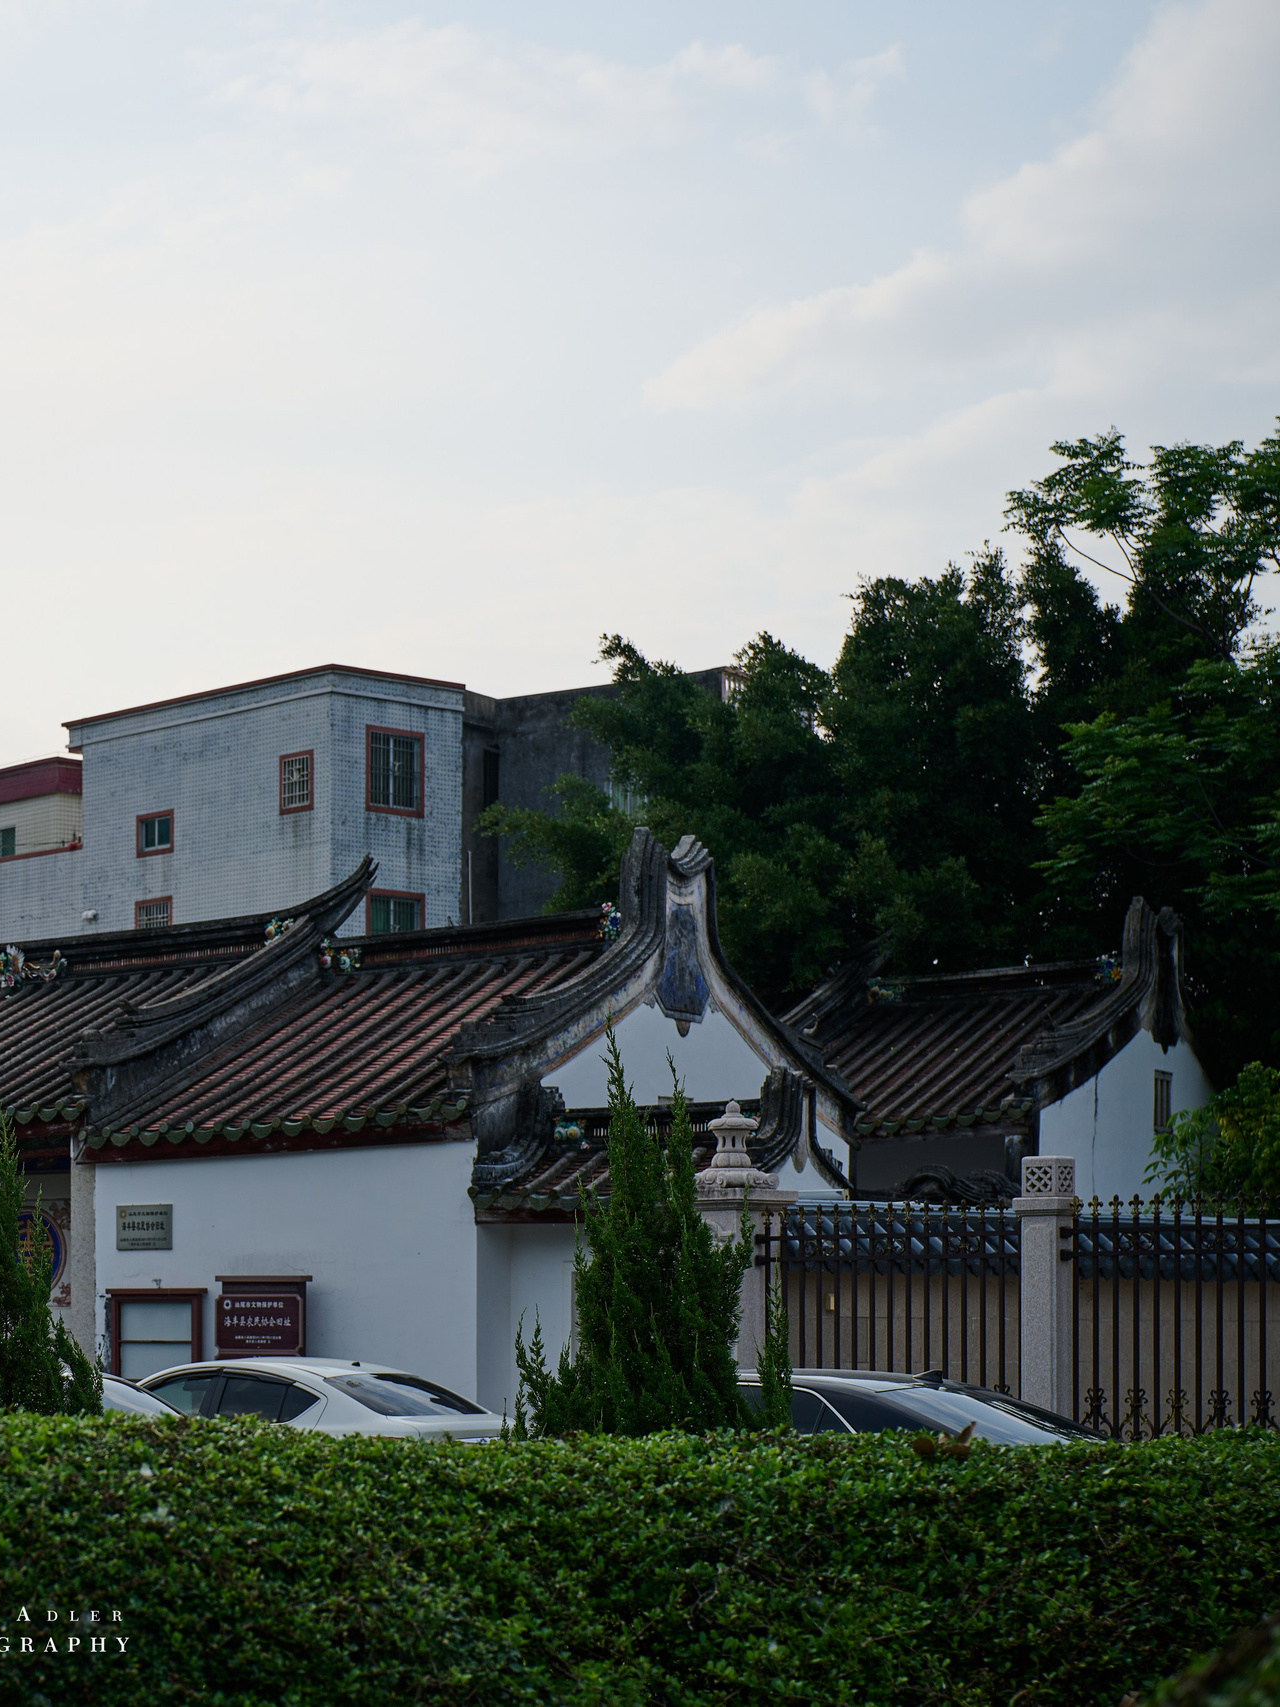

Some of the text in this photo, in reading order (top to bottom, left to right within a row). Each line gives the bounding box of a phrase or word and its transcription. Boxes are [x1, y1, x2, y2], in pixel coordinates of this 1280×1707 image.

[234, 1301, 284, 1309] 汕尾市文物保护单位
[223, 1315, 292, 1328] 海丰县农民协会旧址
